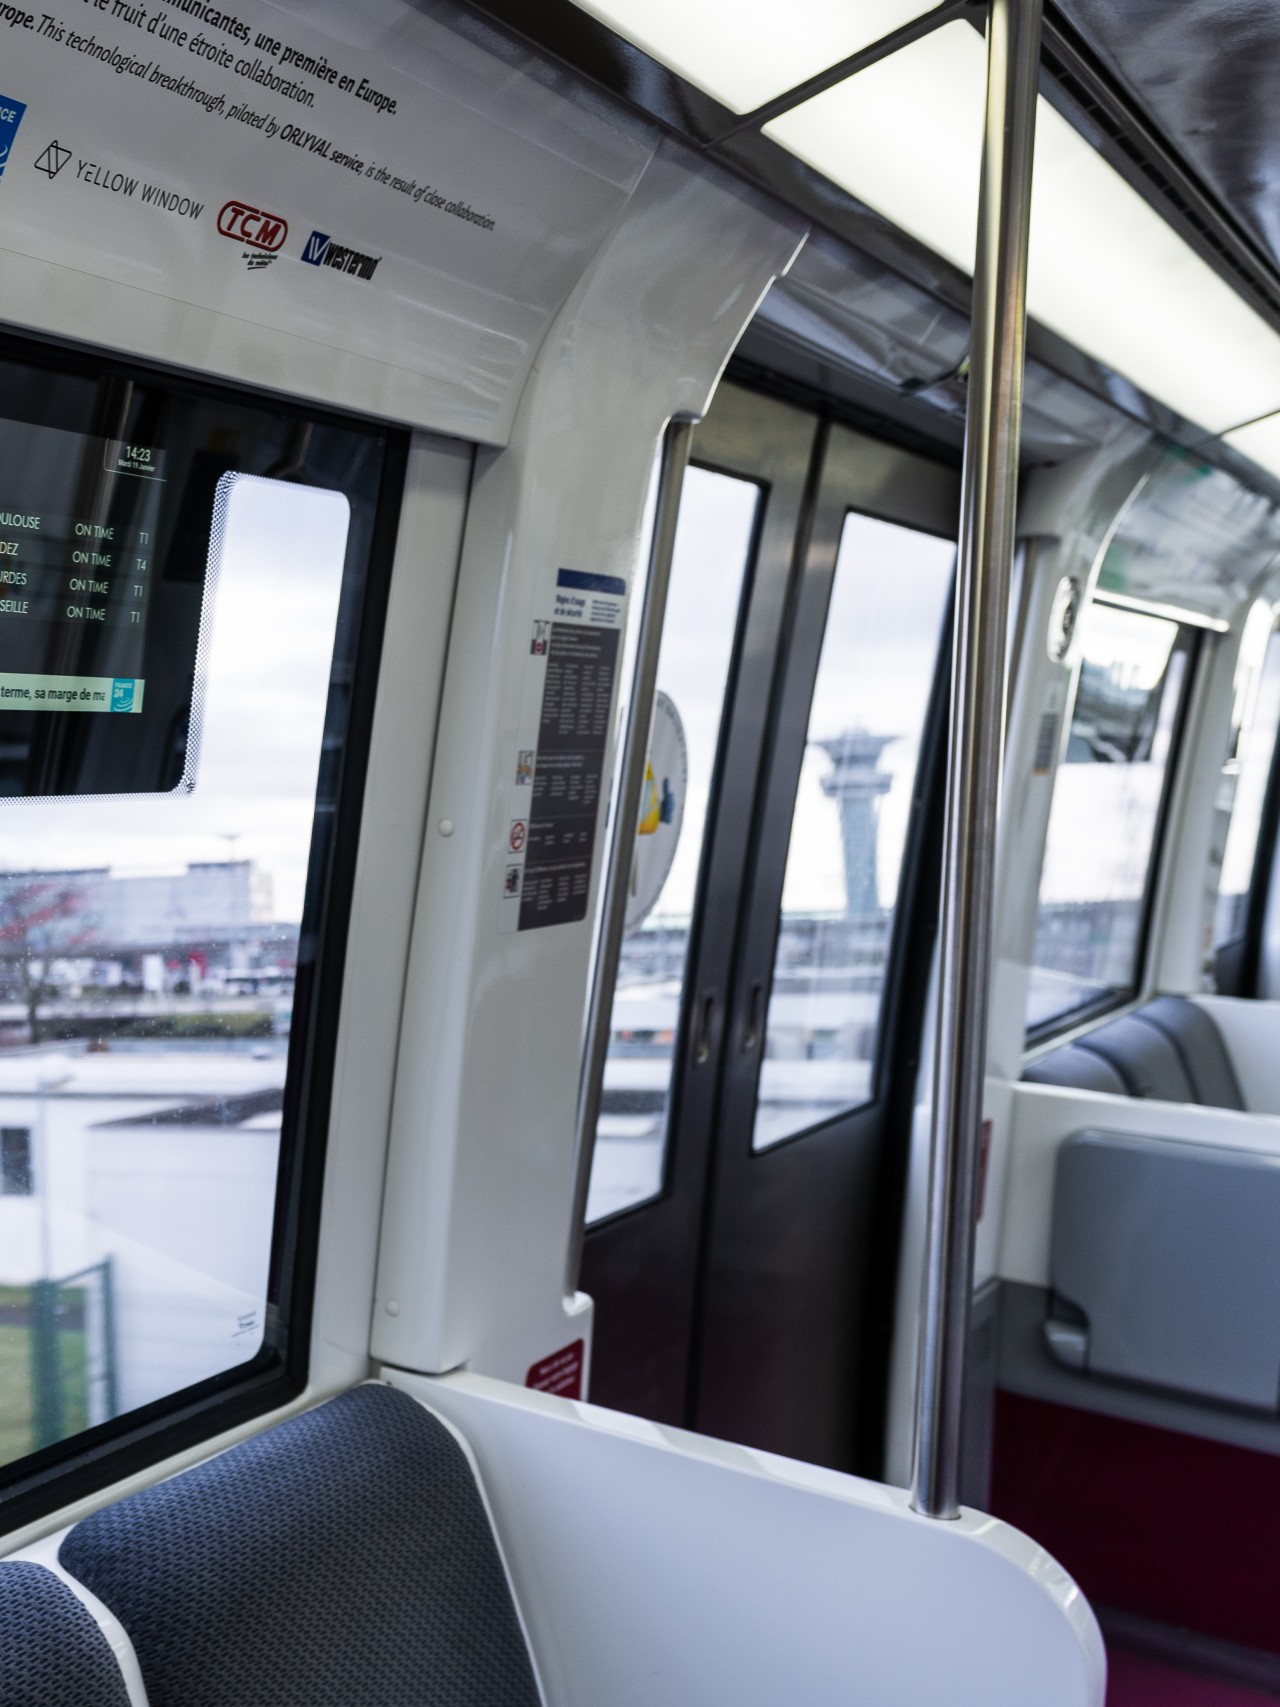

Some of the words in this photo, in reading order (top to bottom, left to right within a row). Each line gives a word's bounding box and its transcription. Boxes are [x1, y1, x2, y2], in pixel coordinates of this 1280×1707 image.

[111, 0, 147, 28] fruit
[189, 32, 234, 68] étroite
[235, 58, 314, 108] collaboration.
[254, 33, 281, 56] une
[278, 46, 338, 84] première
[338, 75, 355, 93] en
[355, 78, 397, 115] Europe.
[36, 14, 66, 42] This
[65, 31, 153, 78] technological
[148, 65, 226, 115] breakthrough,
[224, 103, 270, 130] piloted
[265, 116, 281, 139] by
[280, 124, 332, 158] ORLYVAL
[329, 150, 364, 175] service,
[365, 162, 375, 177] is
[374, 166, 391, 185] the
[390, 176, 416, 196] result
[413, 185, 430, 203] of
[424, 189, 446, 209] close
[444, 201, 496, 231] collaboration.
[76, 160, 139, 197] YELLOW
[141, 183, 204, 219] WINDOW
[227, 207, 282, 246] TCM
[126, 446, 151, 462] 14:23
[75, 523, 92, 536] ON
[93, 525, 114, 540] TIME
[139, 532, 148, 544] T1
[72, 551, 89, 564] ON
[91, 552, 112, 567] TIME
[136, 558, 146, 571] T4
[69, 578, 86, 592] ON
[88, 580, 109, 594] TIME
[133, 585, 143, 597] T1
[67, 606, 83, 618] ON
[85, 607, 106, 621] TIME
[130, 611, 140, 623] T1
[1, 686, 32, 700] terme,
[34, 689, 46, 698] sa
[48, 690, 77, 703] marge
[79, 688, 91, 700] de
[113, 688, 124, 698] 24
